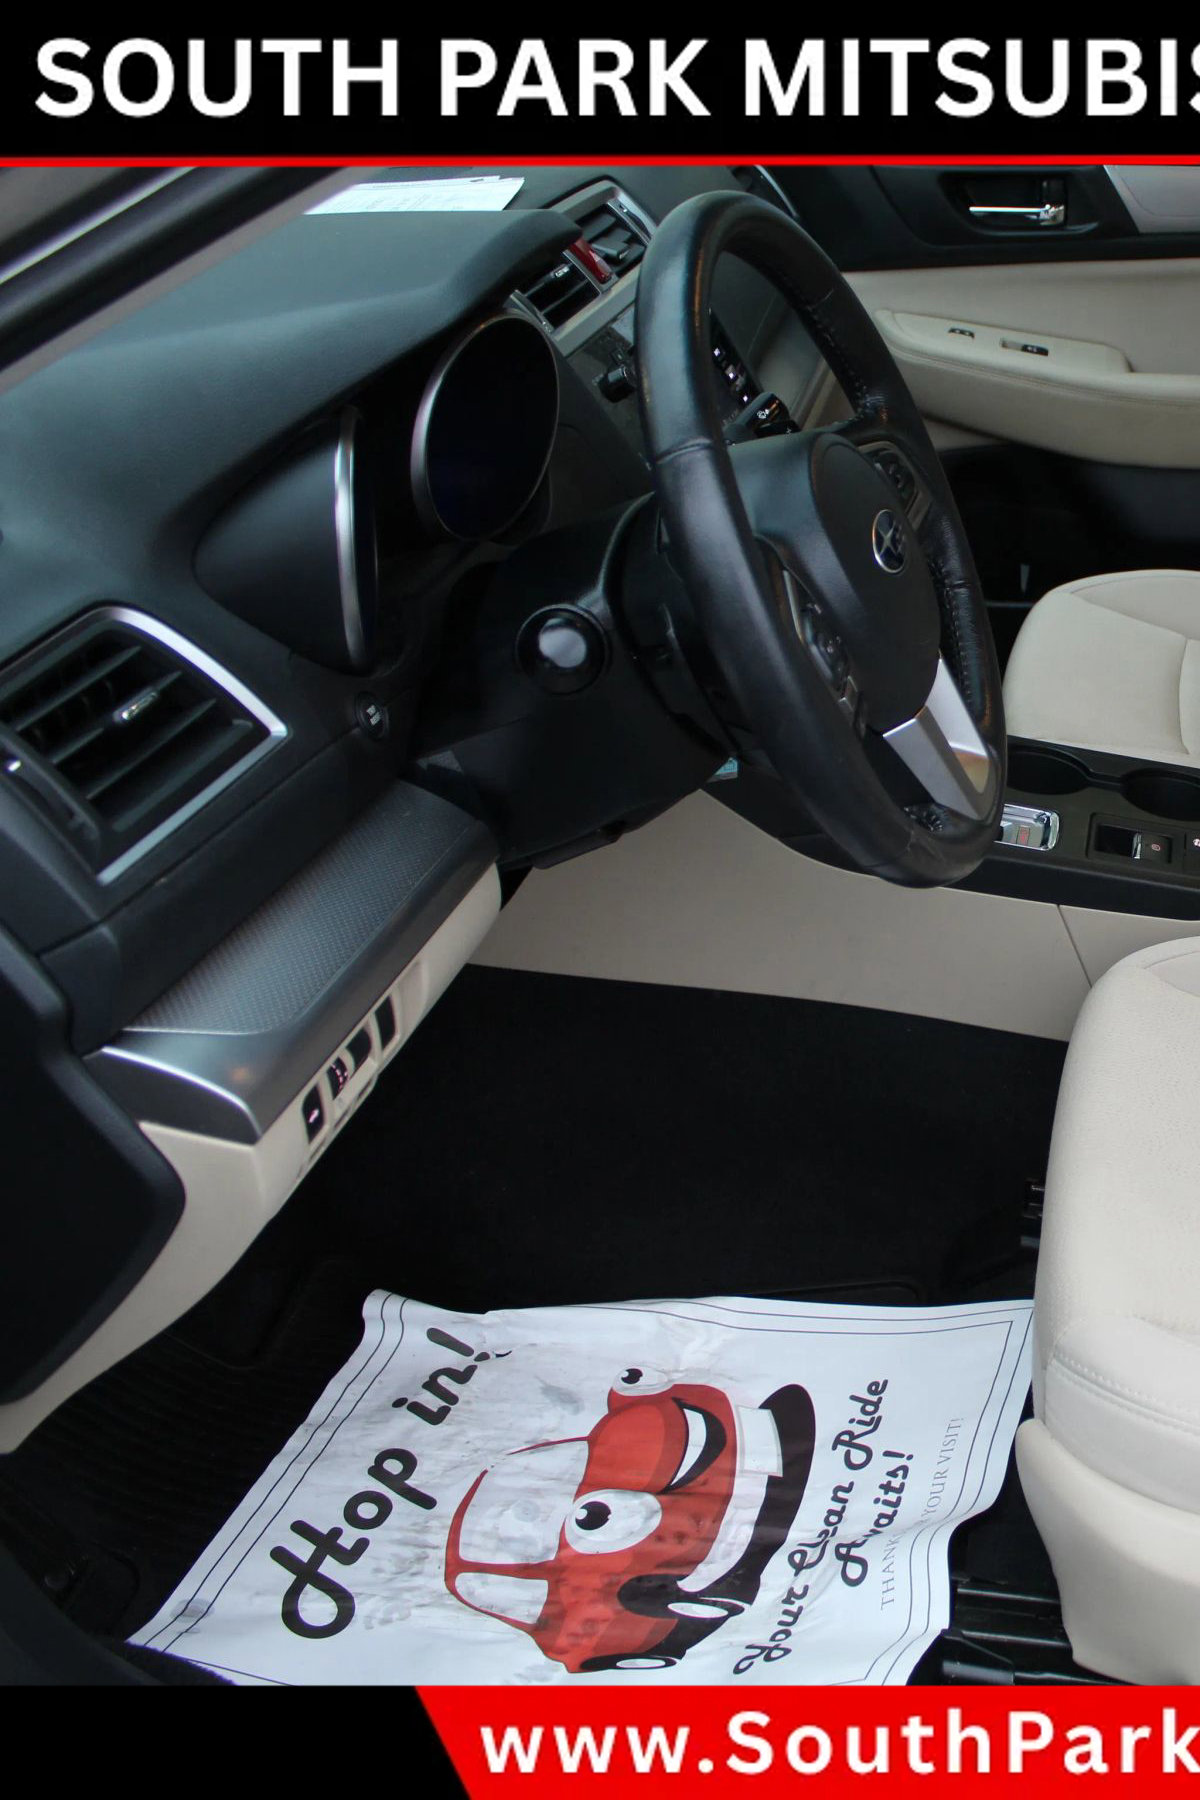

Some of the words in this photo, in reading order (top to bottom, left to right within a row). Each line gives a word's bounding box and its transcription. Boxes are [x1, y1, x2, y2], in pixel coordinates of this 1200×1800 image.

[270, 1448, 437, 1639] Hop
[392, 1327, 490, 1425] in!
[733, 1584, 809, 1675] Your
[832, 1379, 889, 1471] Ride
[938, 1418, 964, 1468] VISIT!
